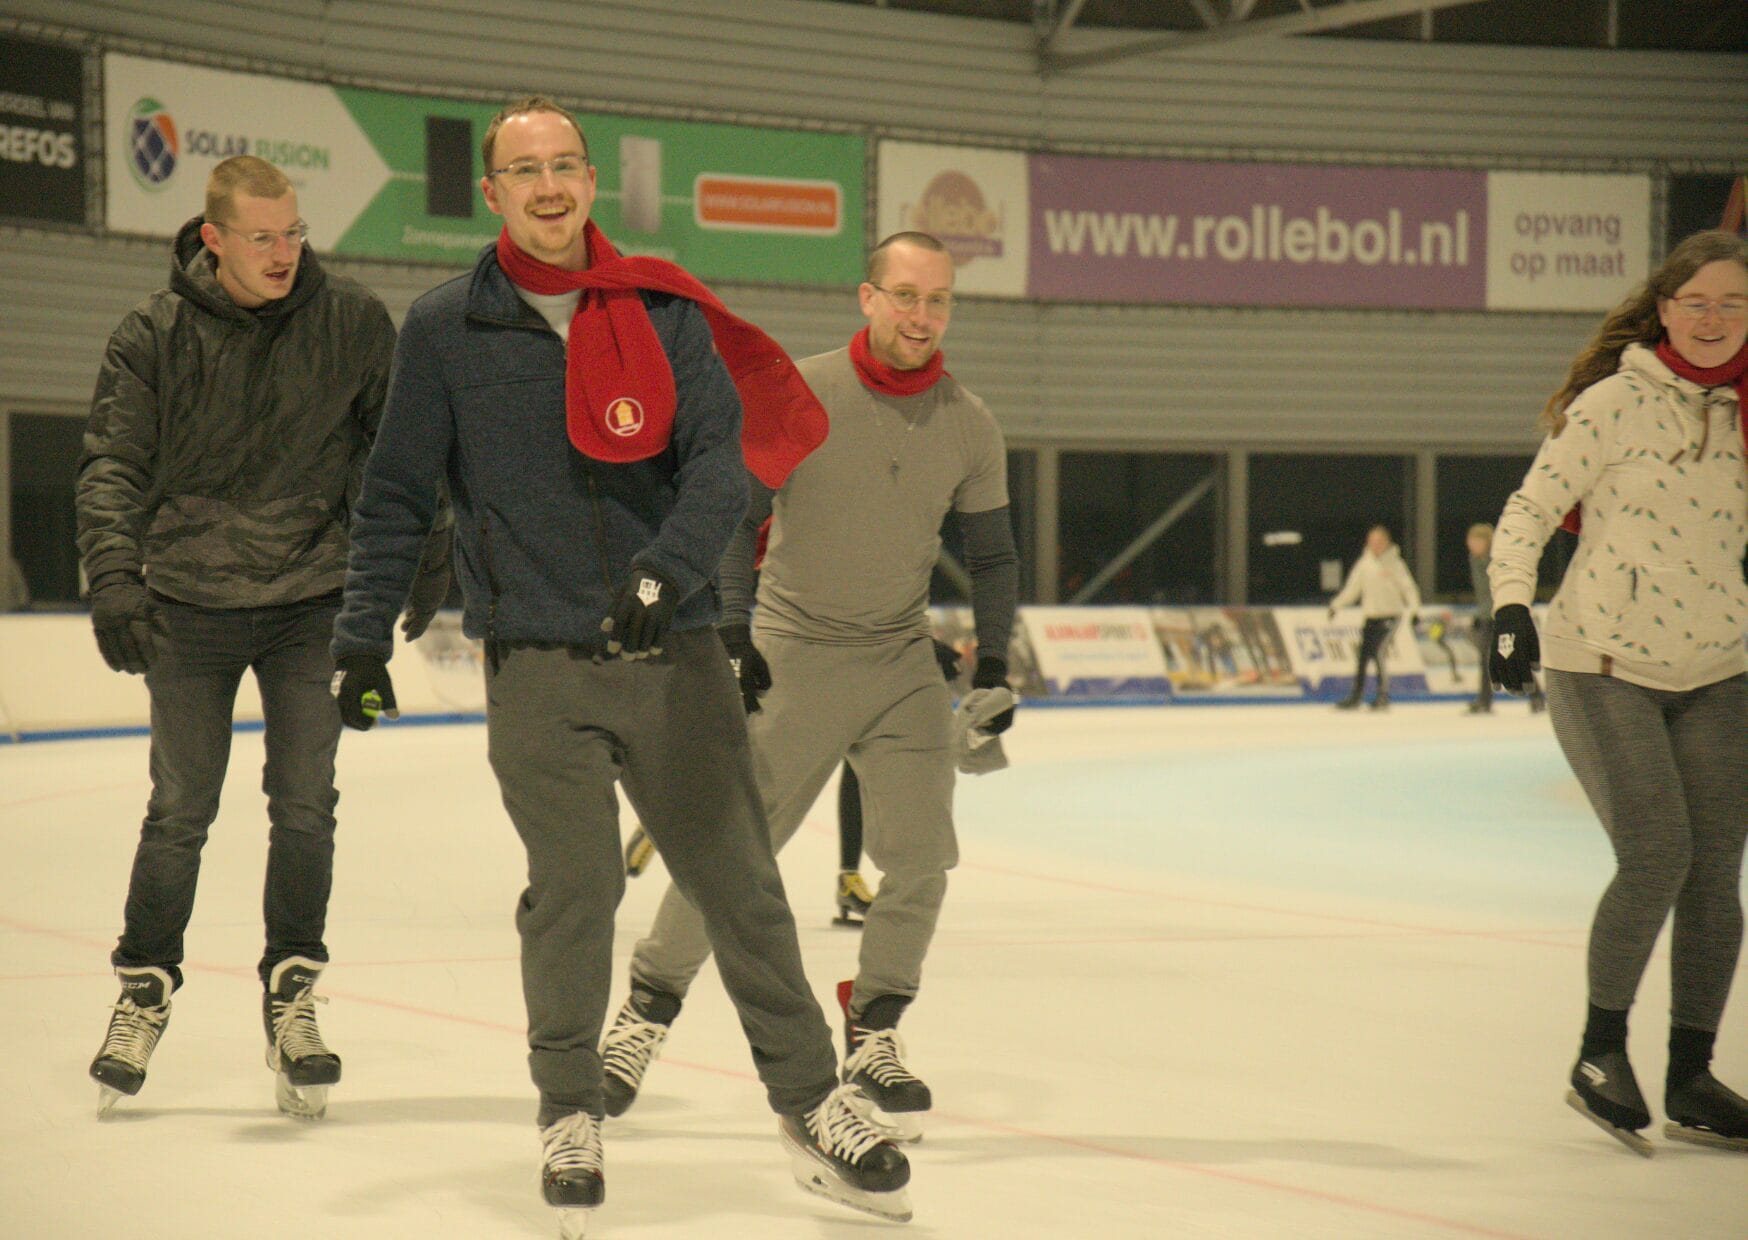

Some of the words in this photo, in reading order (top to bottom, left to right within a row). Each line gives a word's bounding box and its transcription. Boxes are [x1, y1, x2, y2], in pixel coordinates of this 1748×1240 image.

[184, 129, 249, 156] SOLAR
[255, 138, 330, 170] FUSION
[1044, 204, 1470, 266] www.rollebol.nl
[1514, 211, 1621, 245] opvang
[1510, 252, 1546, 282] op
[1555, 249, 1626, 278] maat
